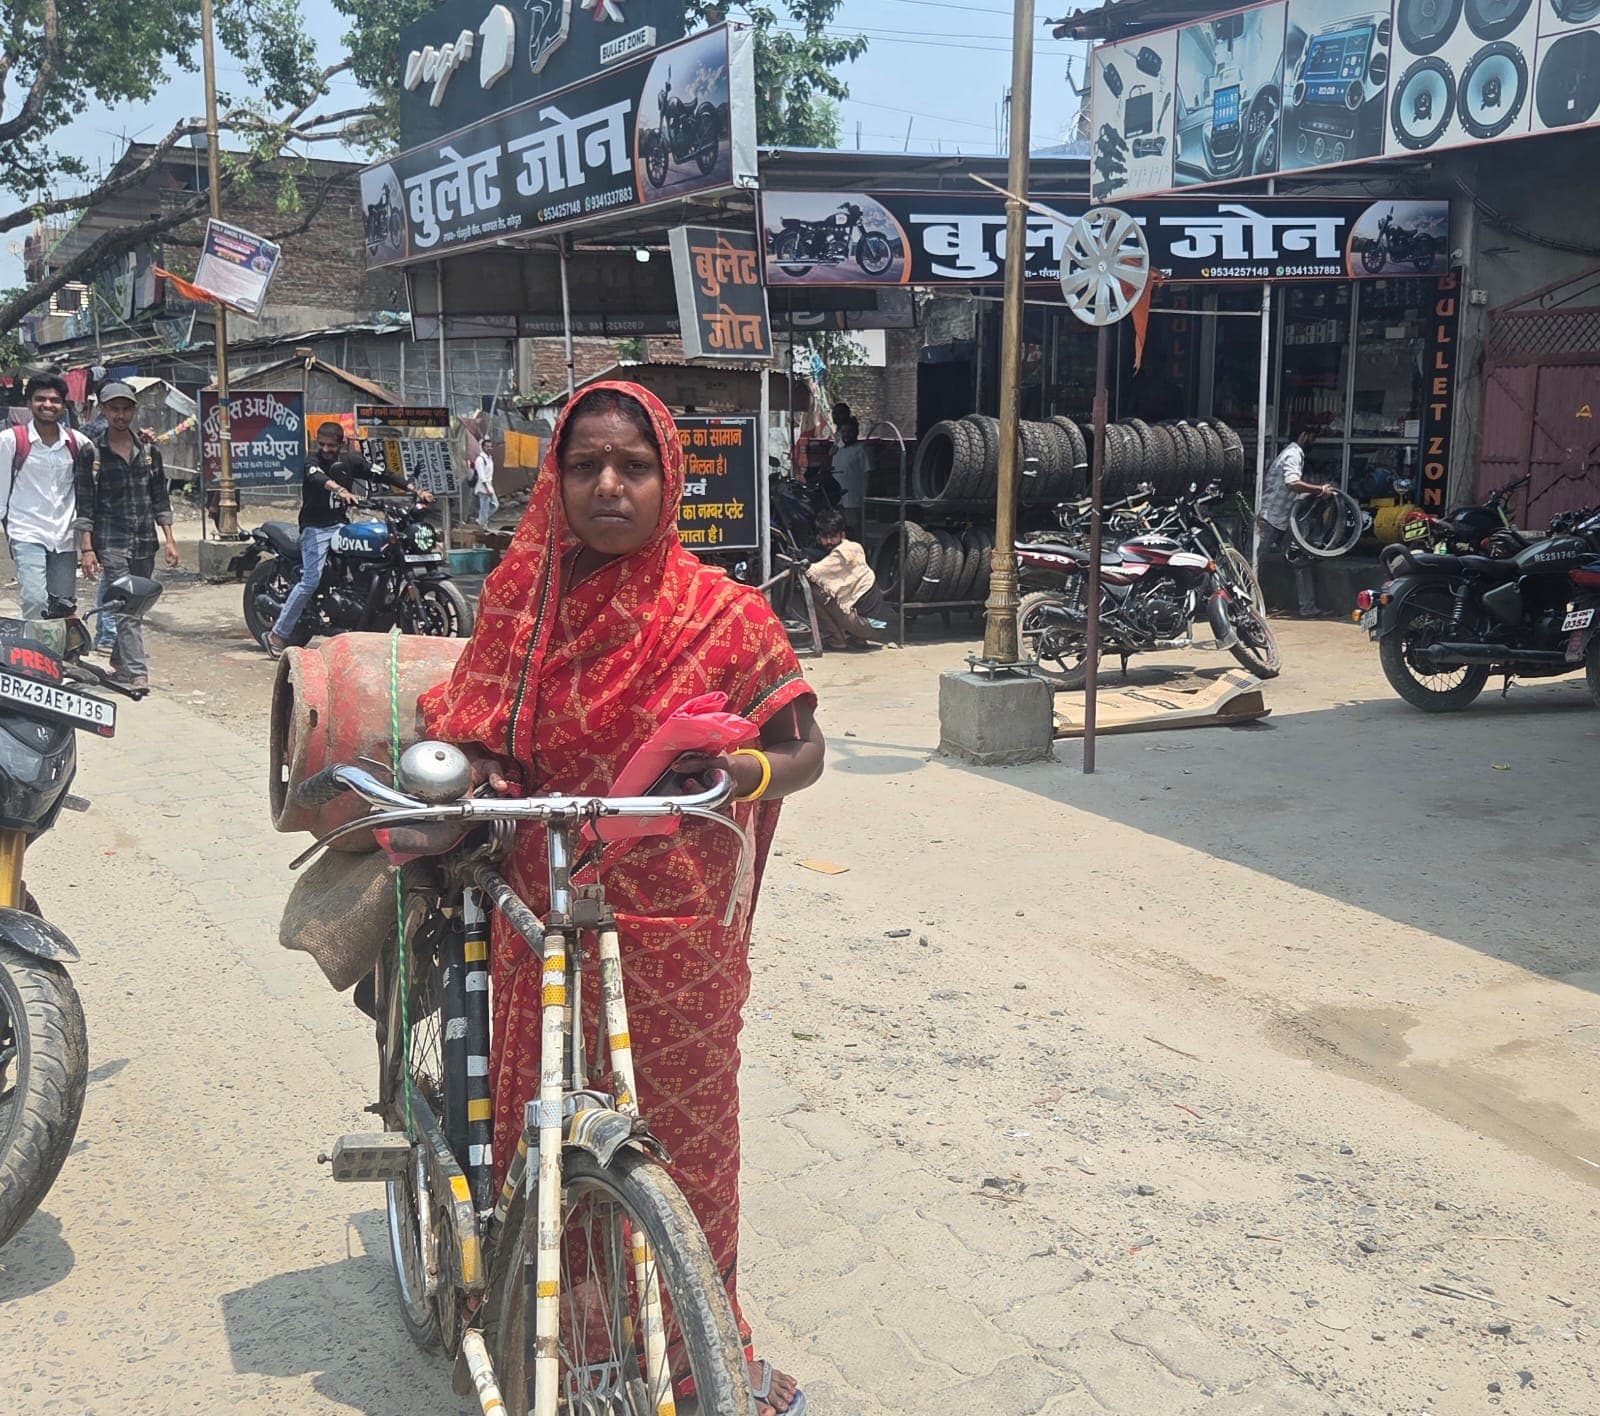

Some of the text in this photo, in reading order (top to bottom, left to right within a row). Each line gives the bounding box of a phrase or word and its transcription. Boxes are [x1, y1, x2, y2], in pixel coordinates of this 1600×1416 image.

[602, 30, 647, 60] BULLET ZONE
[403, 100, 634, 248] बुलेट जोन
[1159, 204, 1345, 259] जोन
[690, 237, 758, 297] बुलेट
[1210, 266, 1341, 277] 9534257148 9341337883
[702, 303, 764, 350] जोन
[244, 393, 300, 432] अधीक्षक
[251, 434, 299, 460] मधेपुरा
[693, 429, 708, 447] का
[709, 428, 743, 447] सामान
[689, 453, 715, 475] मिलता
[1424, 437, 1445, 517] ZON
[683, 478, 707, 496] एवं
[682, 504, 697, 520] का
[697, 503, 723, 520] नम्बर
[725, 497, 744, 520] प्लेट
[336, 535, 373, 551] ROYAL
[10, 647, 60, 679] PRESS
